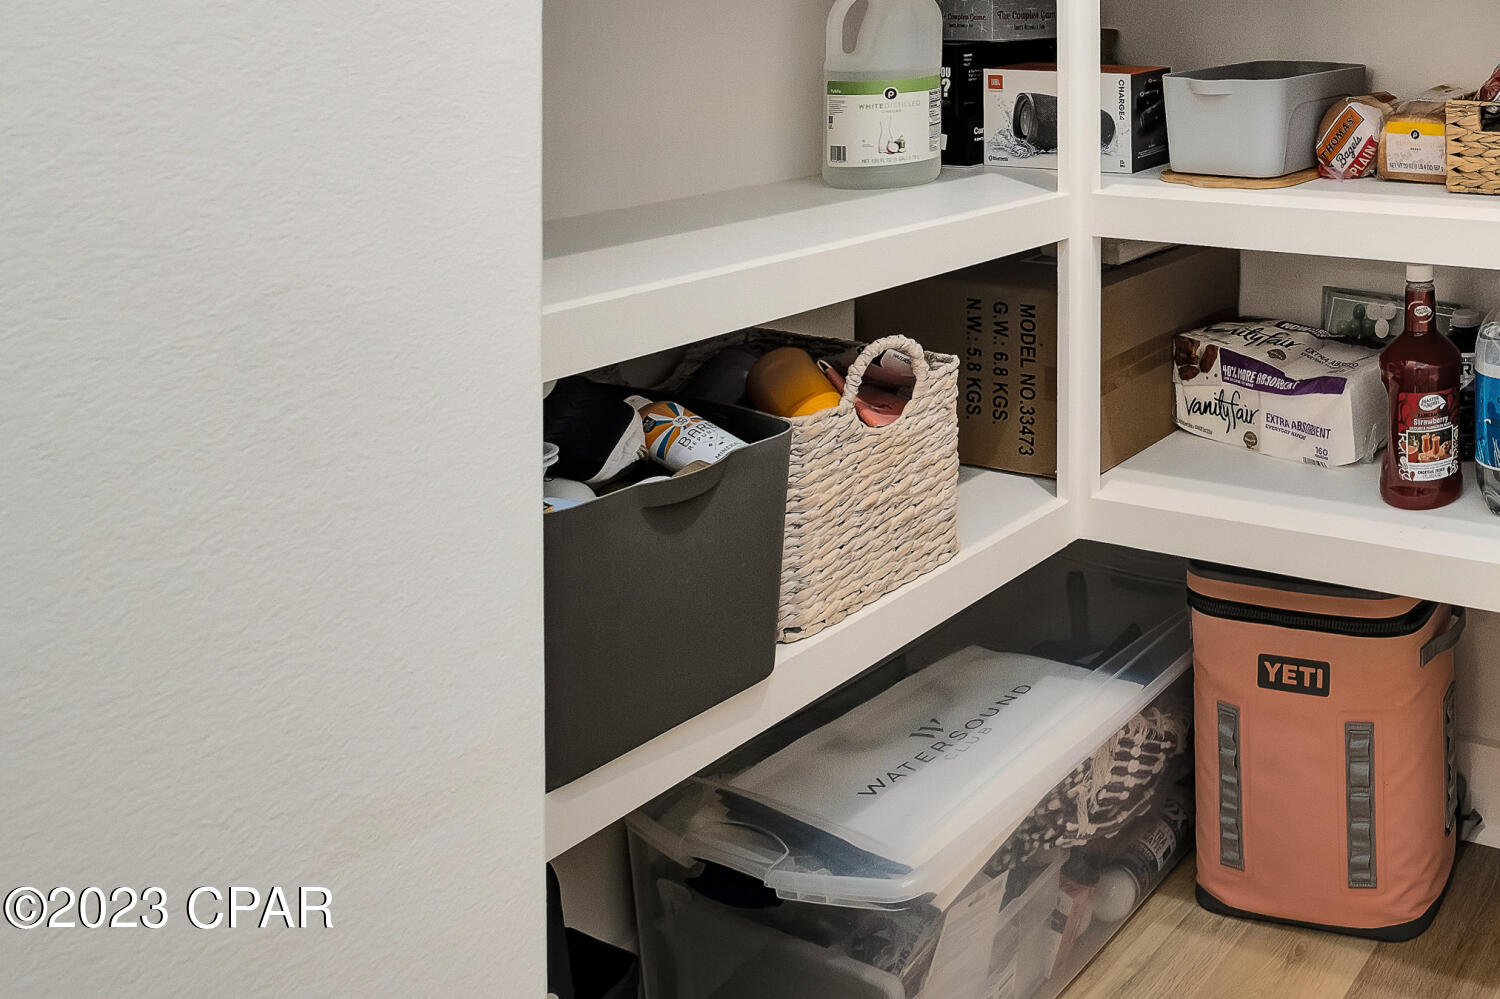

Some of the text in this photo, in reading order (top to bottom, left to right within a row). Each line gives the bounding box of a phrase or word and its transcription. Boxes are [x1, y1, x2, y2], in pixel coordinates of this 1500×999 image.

[884, 100, 921, 109] DISTILLED
[1336, 136, 1363, 168] Bagels
[1350, 144, 1377, 178] PLAIN
[967, 346, 983, 375] 5.8
[993, 352, 1010, 378] 6.8
[1019, 304, 1036, 457] MODEL NO.33473
[1222, 364, 1300, 391] 40% MORE ABSORBENT
[966, 377, 982, 420] KGS.
[992, 380, 1010, 425] KGS.
[1264, 424, 1290, 436] EVERYDAY
[1266, 412, 1332, 440] EXTRA ABSORBENT
[1414, 416, 1449, 426] Strawberry
[1315, 446, 1329, 456] 160
[1264, 661, 1324, 689] YETI
[857, 684, 1033, 798] WATERSOUND
[944, 726, 993, 761] CLUB
